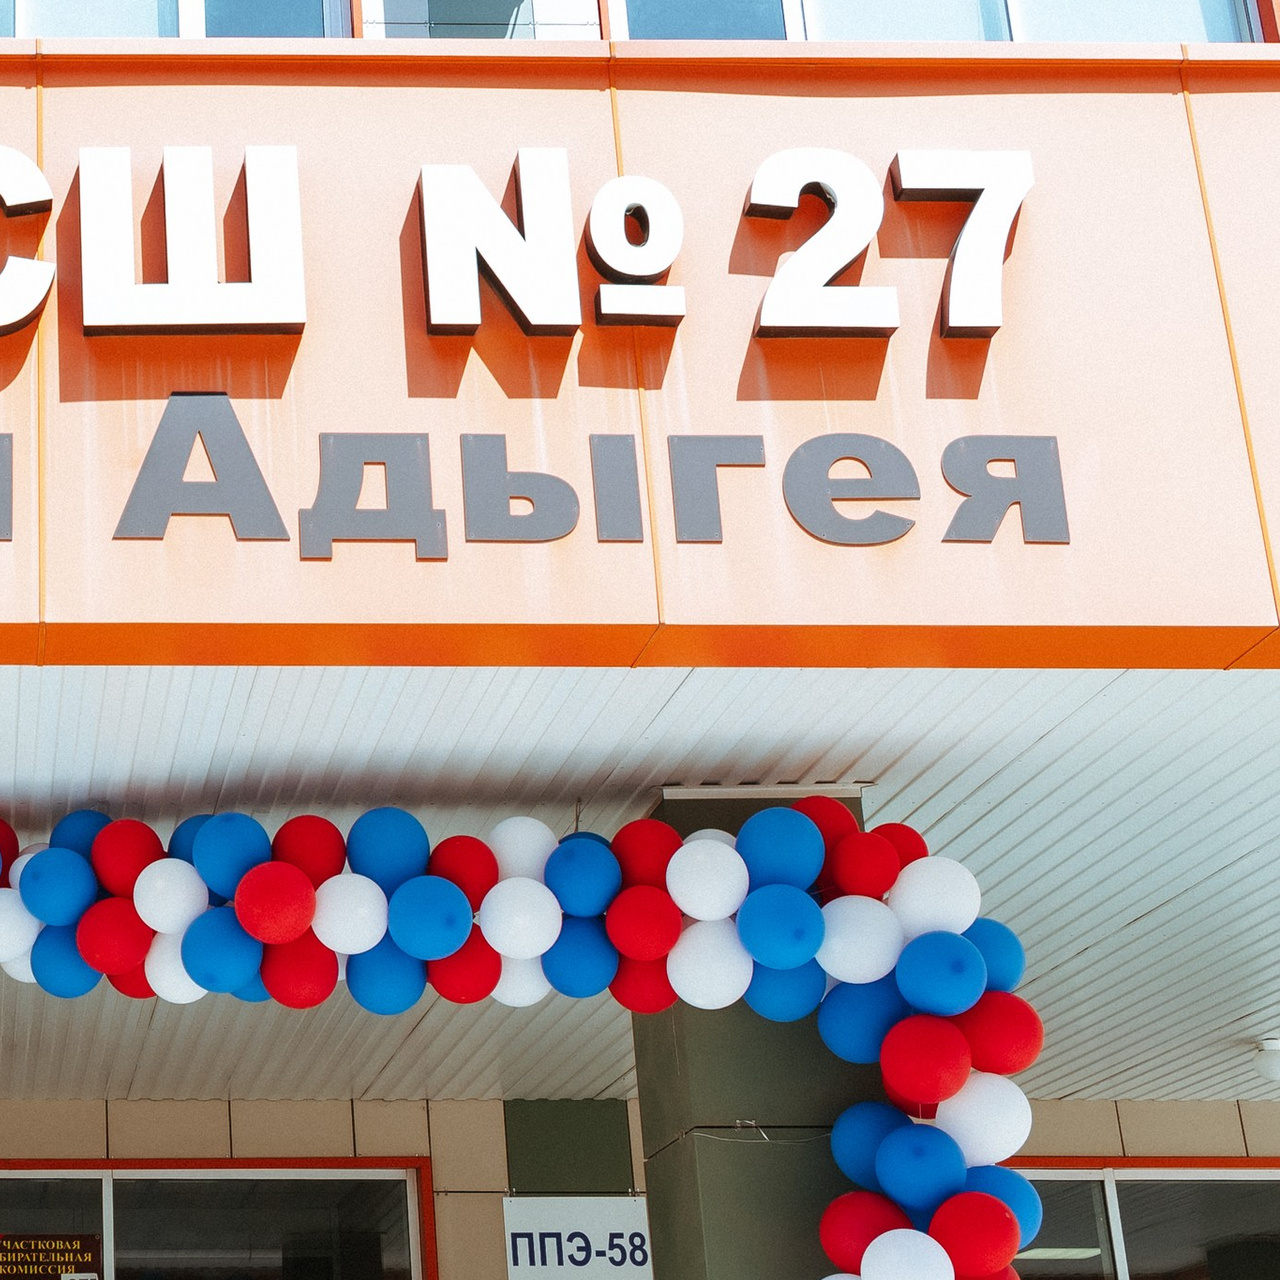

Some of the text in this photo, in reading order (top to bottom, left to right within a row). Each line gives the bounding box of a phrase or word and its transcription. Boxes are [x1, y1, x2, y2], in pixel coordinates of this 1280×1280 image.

[421, 146, 686, 337] №
[744, 147, 1035, 338] 27
[113, 391, 1070, 562] Адыгея
[0, 1265, 75, 1275] КОМИССИЯ
[511, 1231, 648, 1266] ППЭ-58
